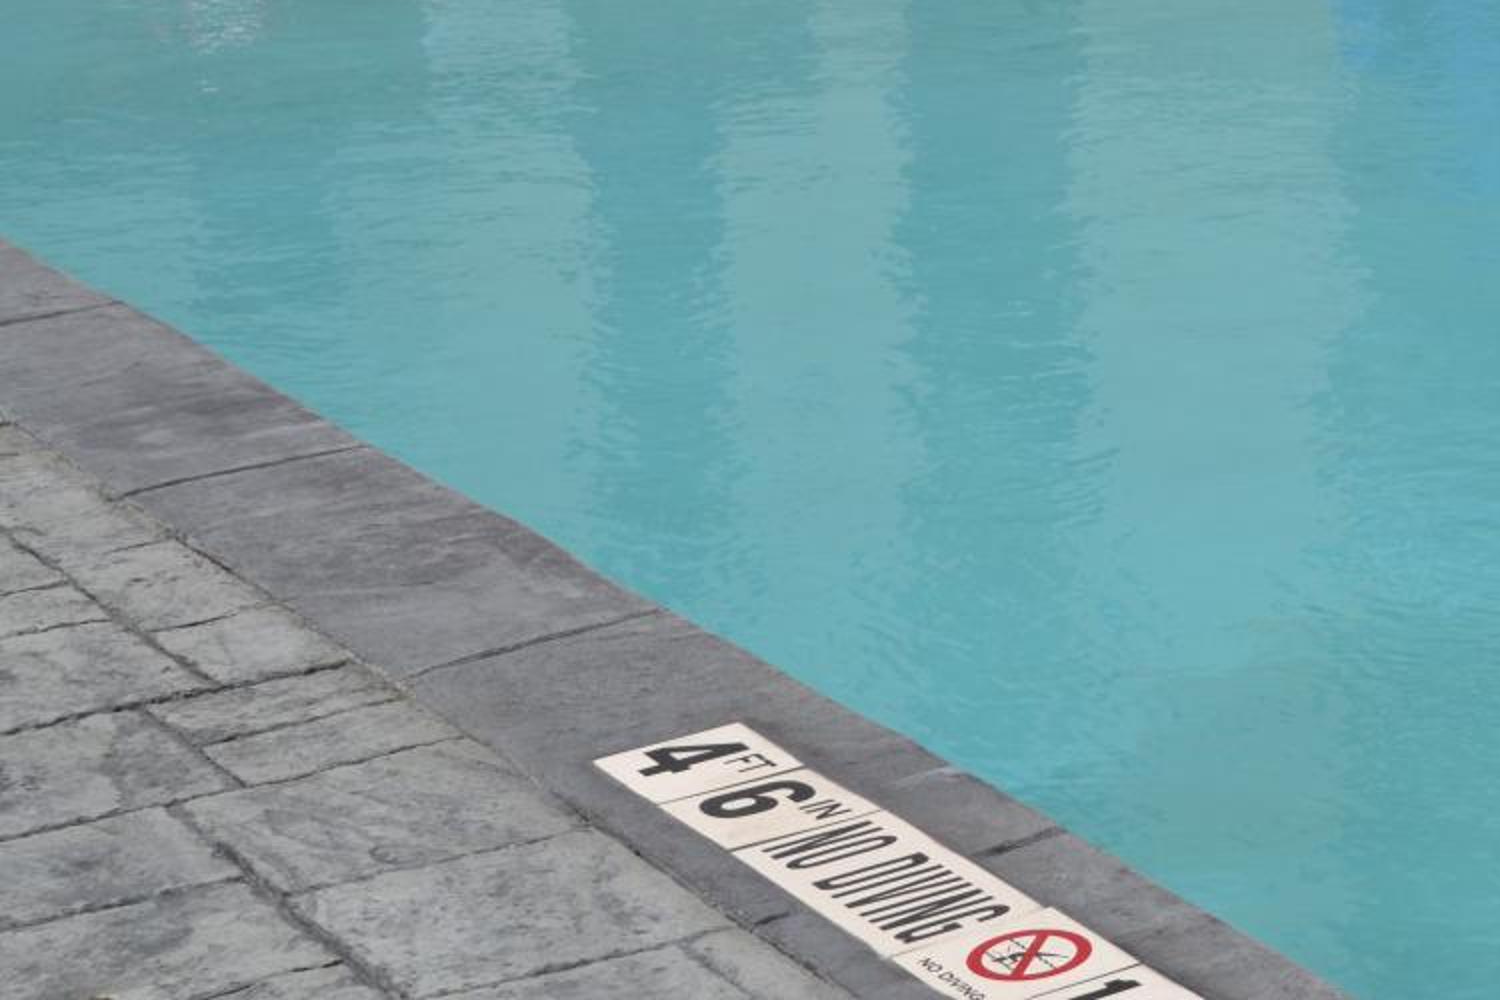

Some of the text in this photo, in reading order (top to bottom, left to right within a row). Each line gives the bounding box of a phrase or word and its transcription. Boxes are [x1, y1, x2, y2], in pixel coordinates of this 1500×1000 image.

[637, 742, 1011, 945] 4 FT 6 IN NO DIVING
[916, 957, 985, 1000] NO DIVING
